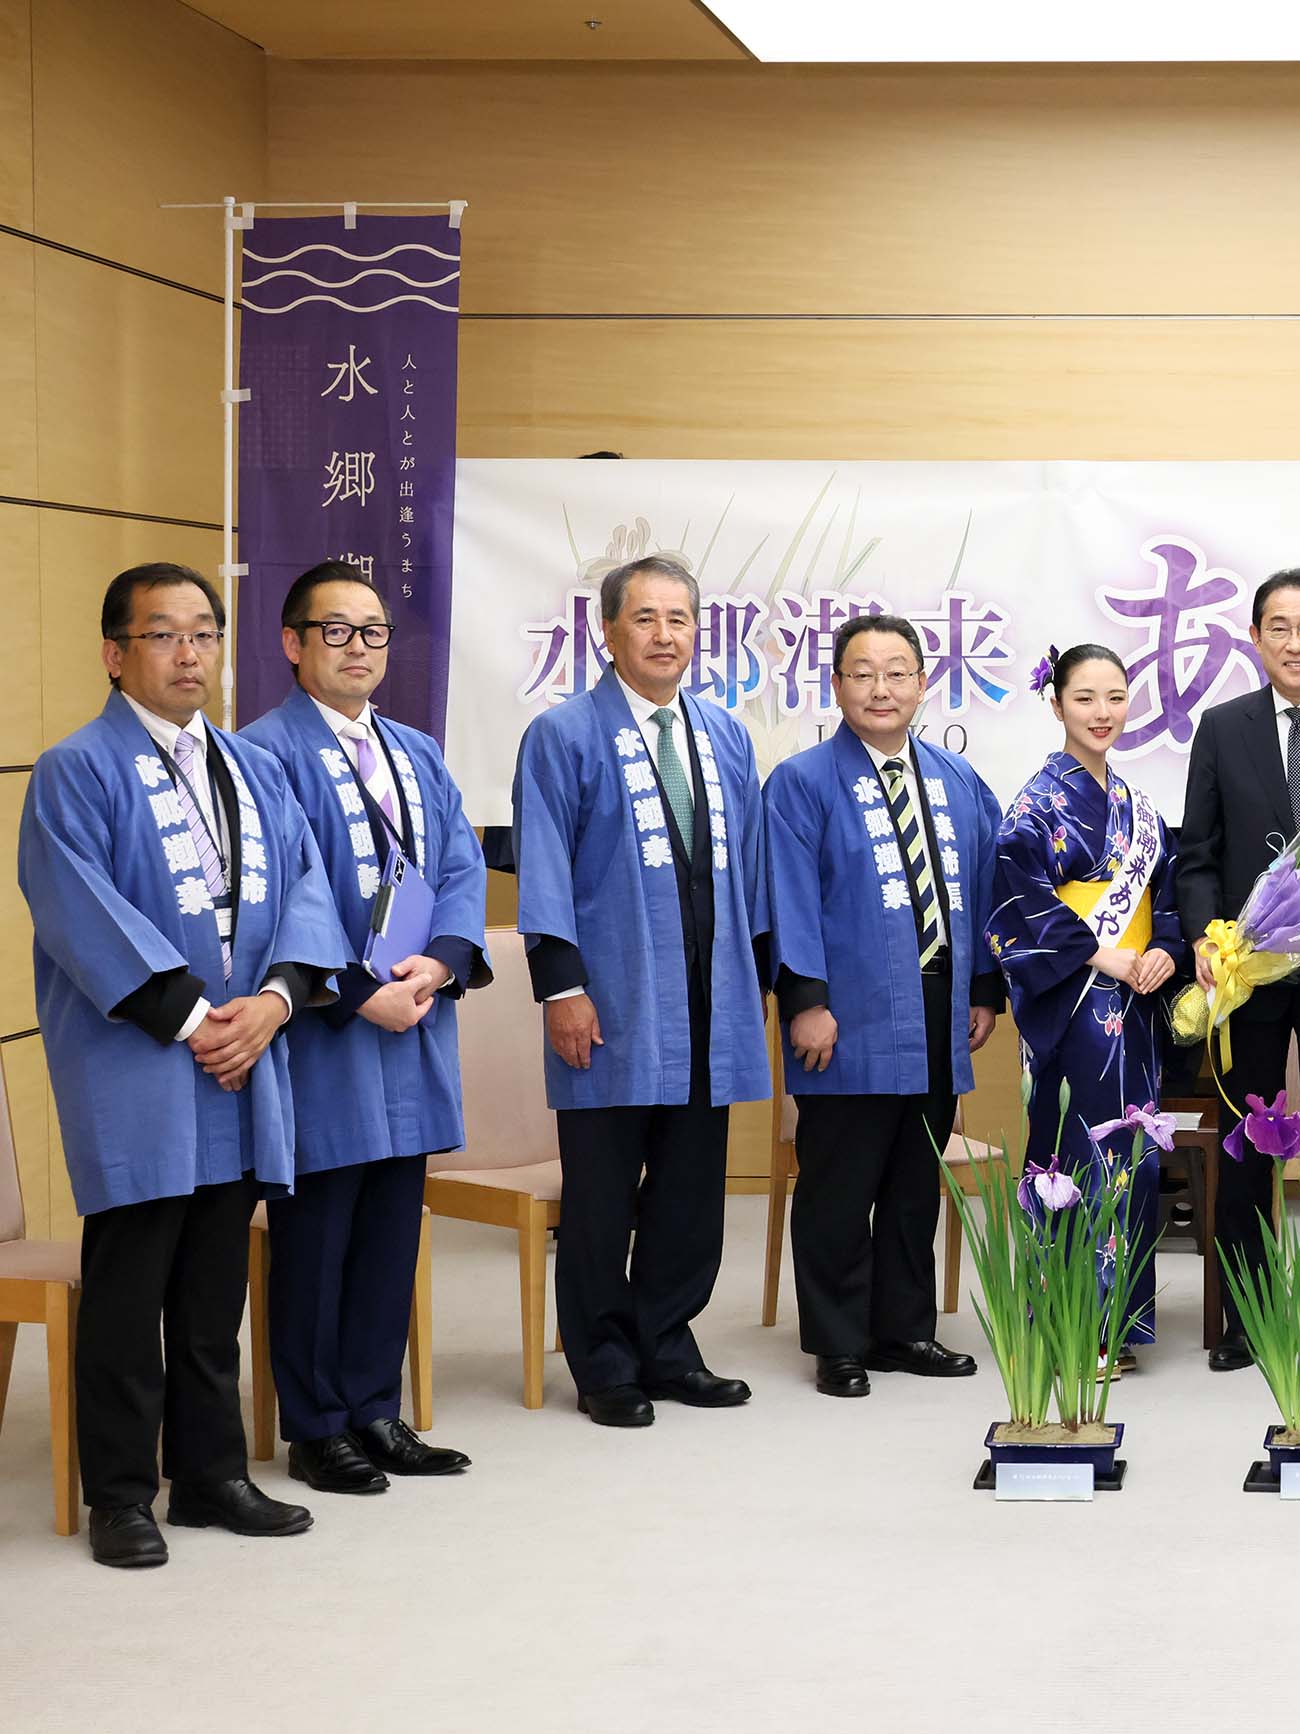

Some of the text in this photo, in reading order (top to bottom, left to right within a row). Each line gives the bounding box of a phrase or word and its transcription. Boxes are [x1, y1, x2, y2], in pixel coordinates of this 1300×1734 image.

[399, 354, 417, 600] 人と人とが出逢うまち
[853, 776, 912, 910] 水郷潮来
[924, 778, 963, 911] 潮来市長
